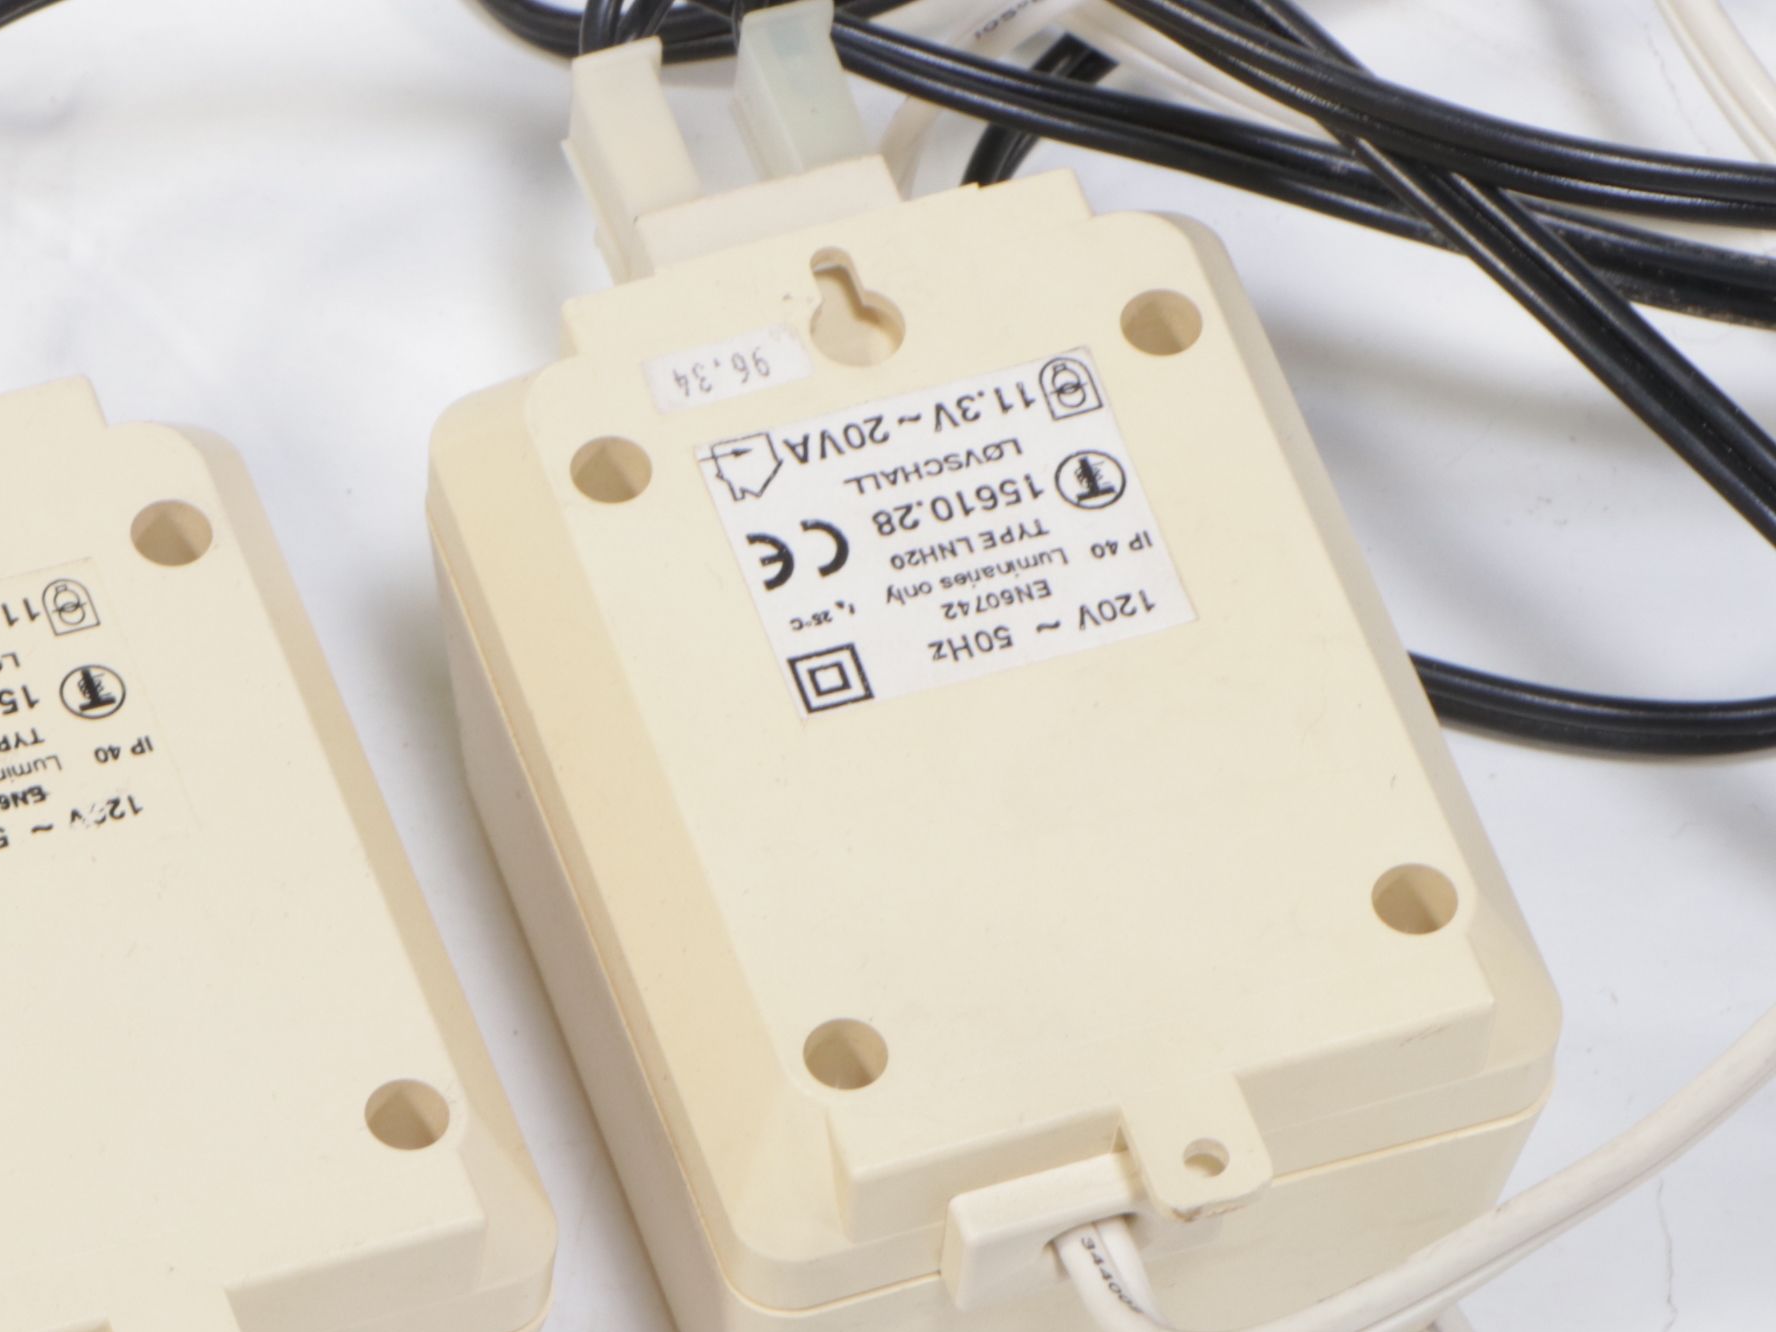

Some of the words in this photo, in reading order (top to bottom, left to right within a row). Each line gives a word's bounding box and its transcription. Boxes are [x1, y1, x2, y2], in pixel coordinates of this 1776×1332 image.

[673, 347, 770, 397] 96.34
[935, 384, 1035, 431] 11.3V
[784, 416, 889, 464] 20VA
[872, 475, 1043, 536] 15610.28
[979, 520, 1048, 549] TYPE
[1091, 541, 1118, 558] 40
[1129, 531, 1152, 551] IP
[890, 537, 974, 570] LNH20
[940, 548, 1068, 589] Luminaries
[887, 582, 932, 604] only
[941, 580, 1051, 619] EN60742
[1080, 591, 1154, 629] 120V
[928, 626, 1013, 661] 50Hz
[94, 746, 120, 763] 40
[131, 737, 153, 755] IP
